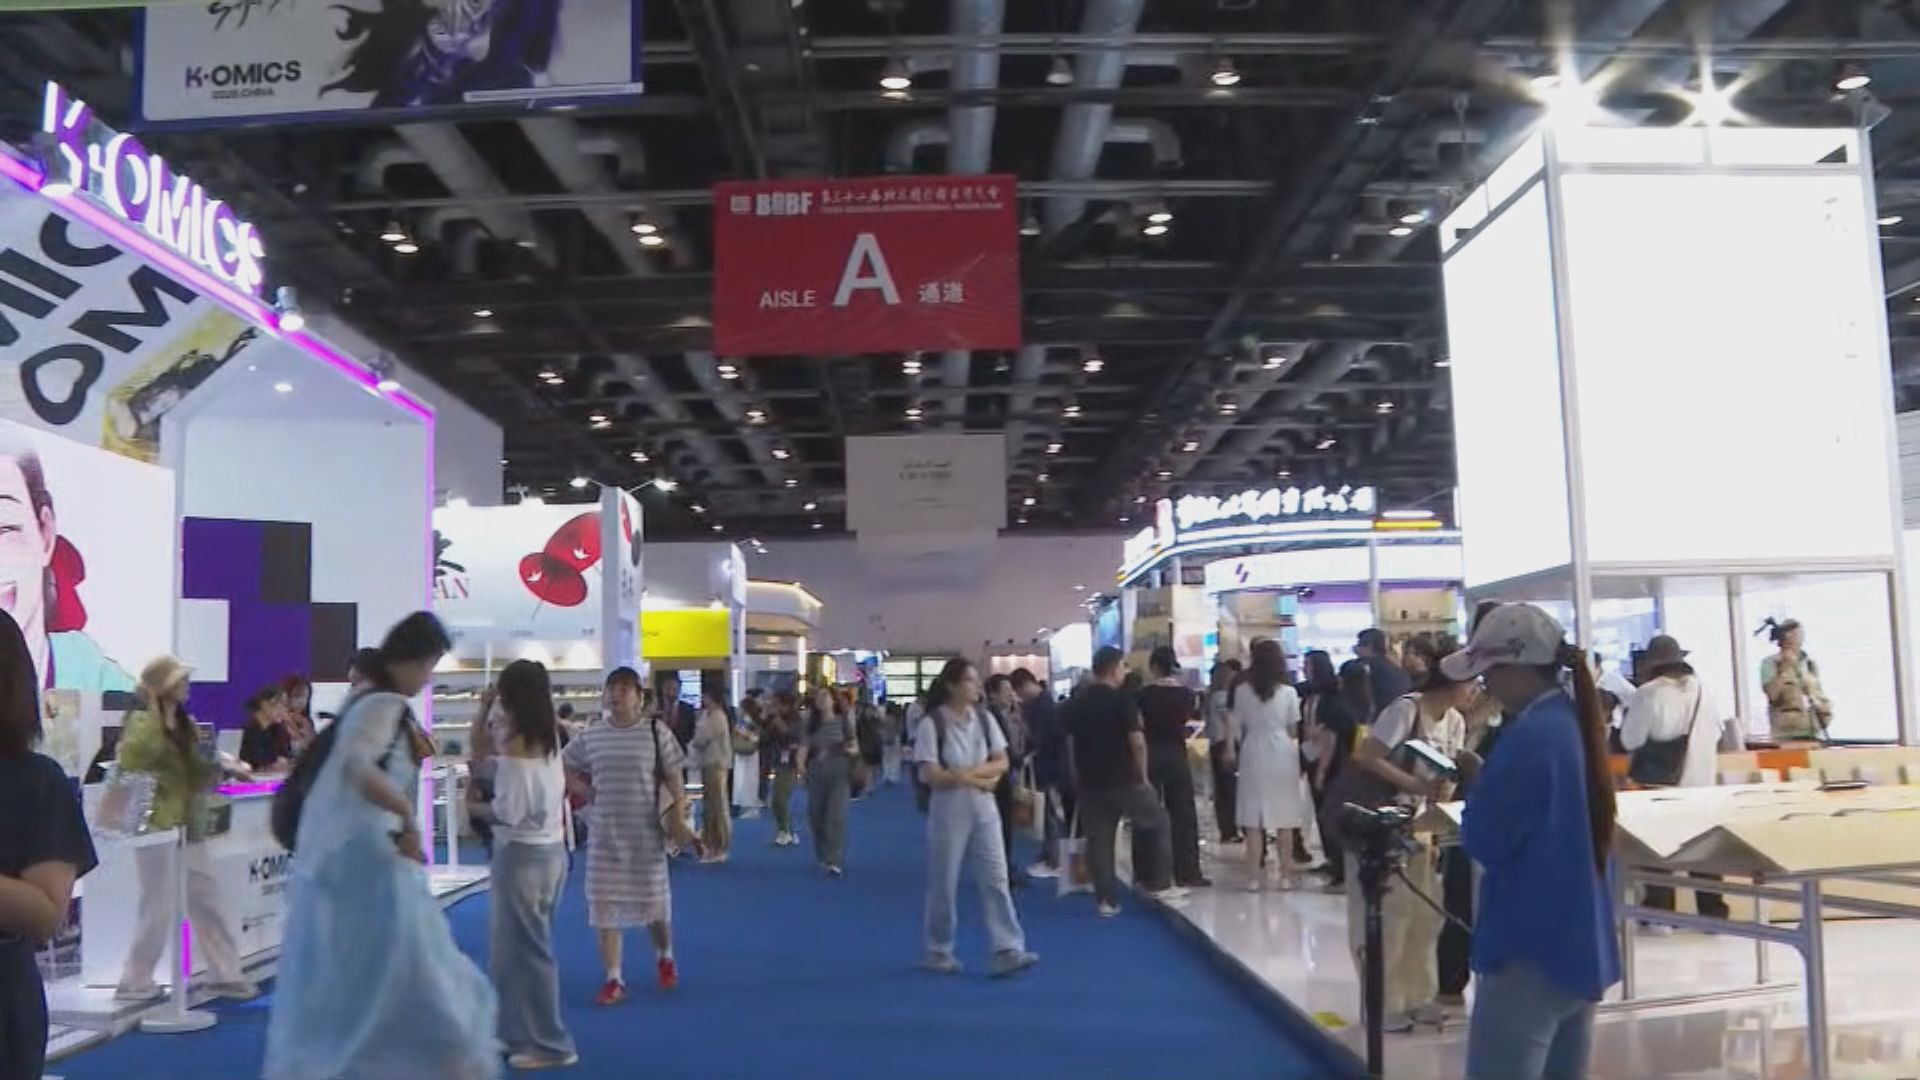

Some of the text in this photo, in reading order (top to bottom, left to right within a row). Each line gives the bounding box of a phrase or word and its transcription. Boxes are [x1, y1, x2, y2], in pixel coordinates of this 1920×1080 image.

[759, 233, 900, 308] AISLE A
[918, 282, 964, 304] 通道
